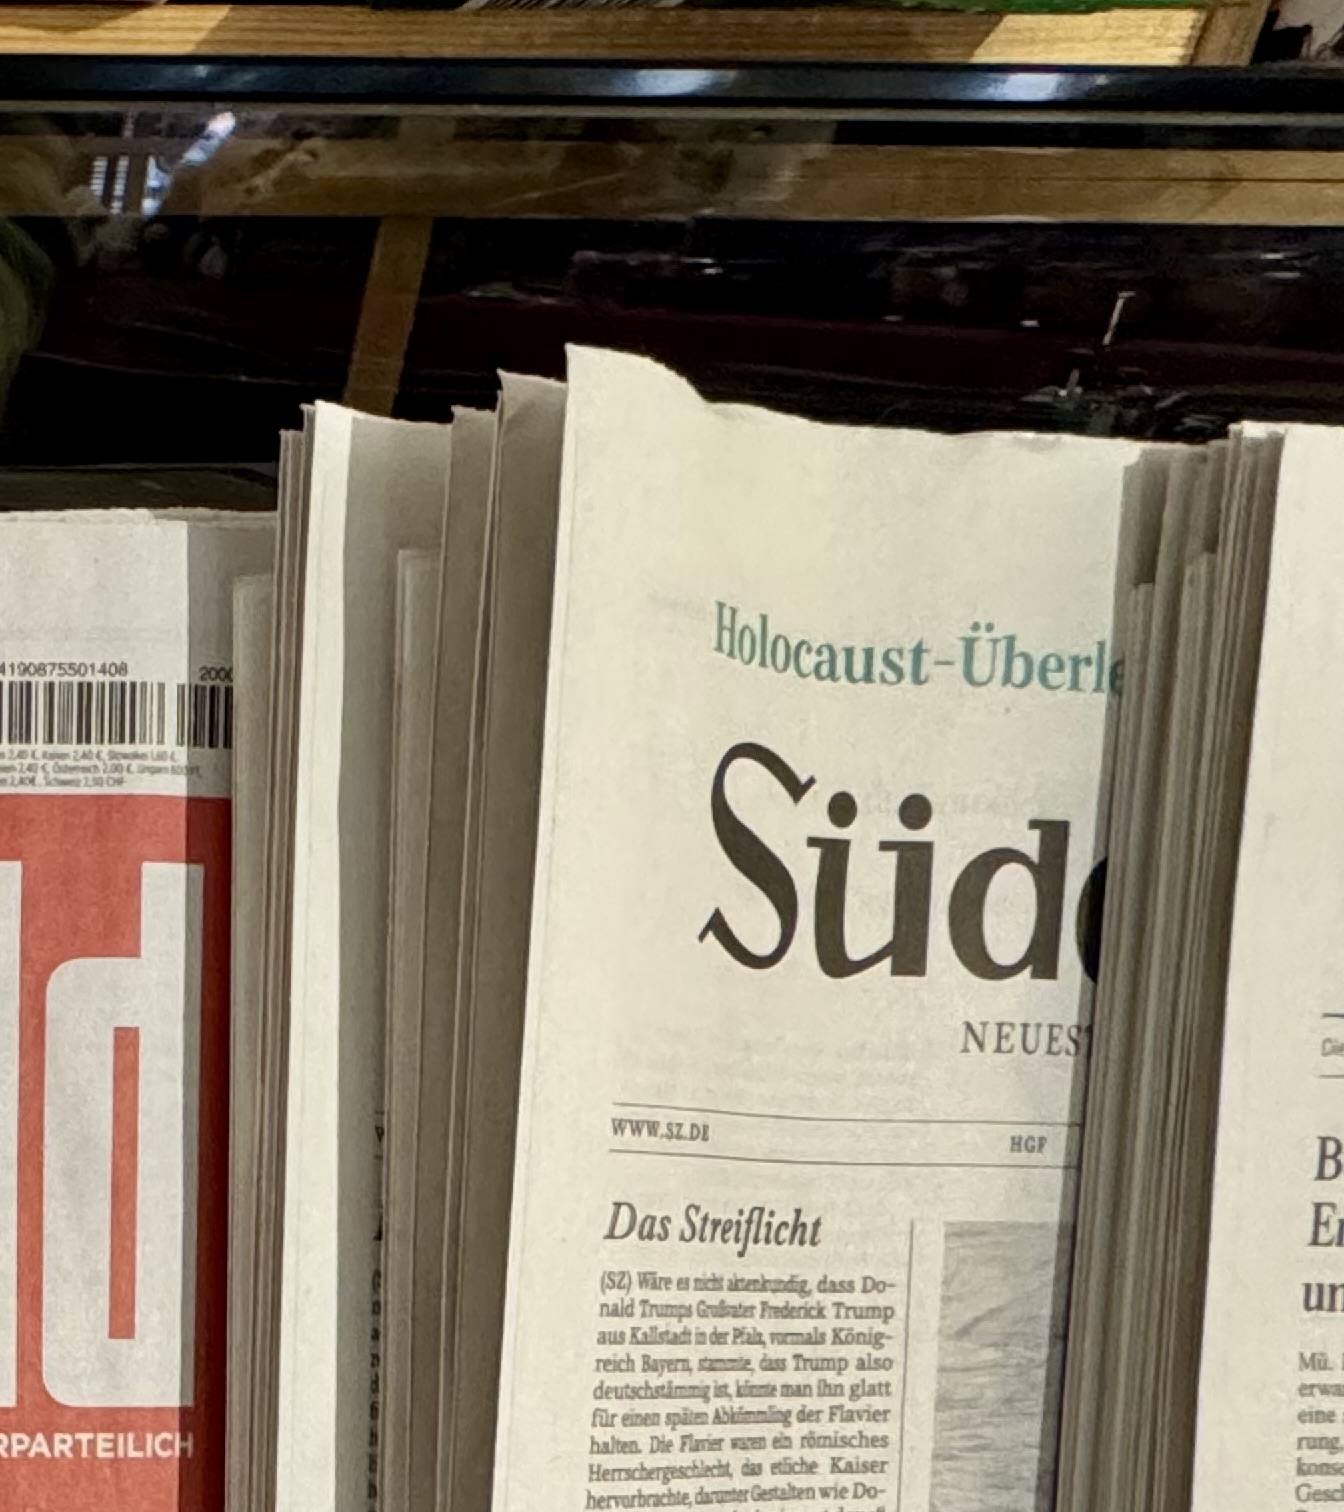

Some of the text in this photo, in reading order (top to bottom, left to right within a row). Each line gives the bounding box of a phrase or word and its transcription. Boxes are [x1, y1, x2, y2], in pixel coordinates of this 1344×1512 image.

[611, 1117, 709, 1142] WWW.SZ.DE
[602, 1201, 822, 1259] Das Streiflicht
